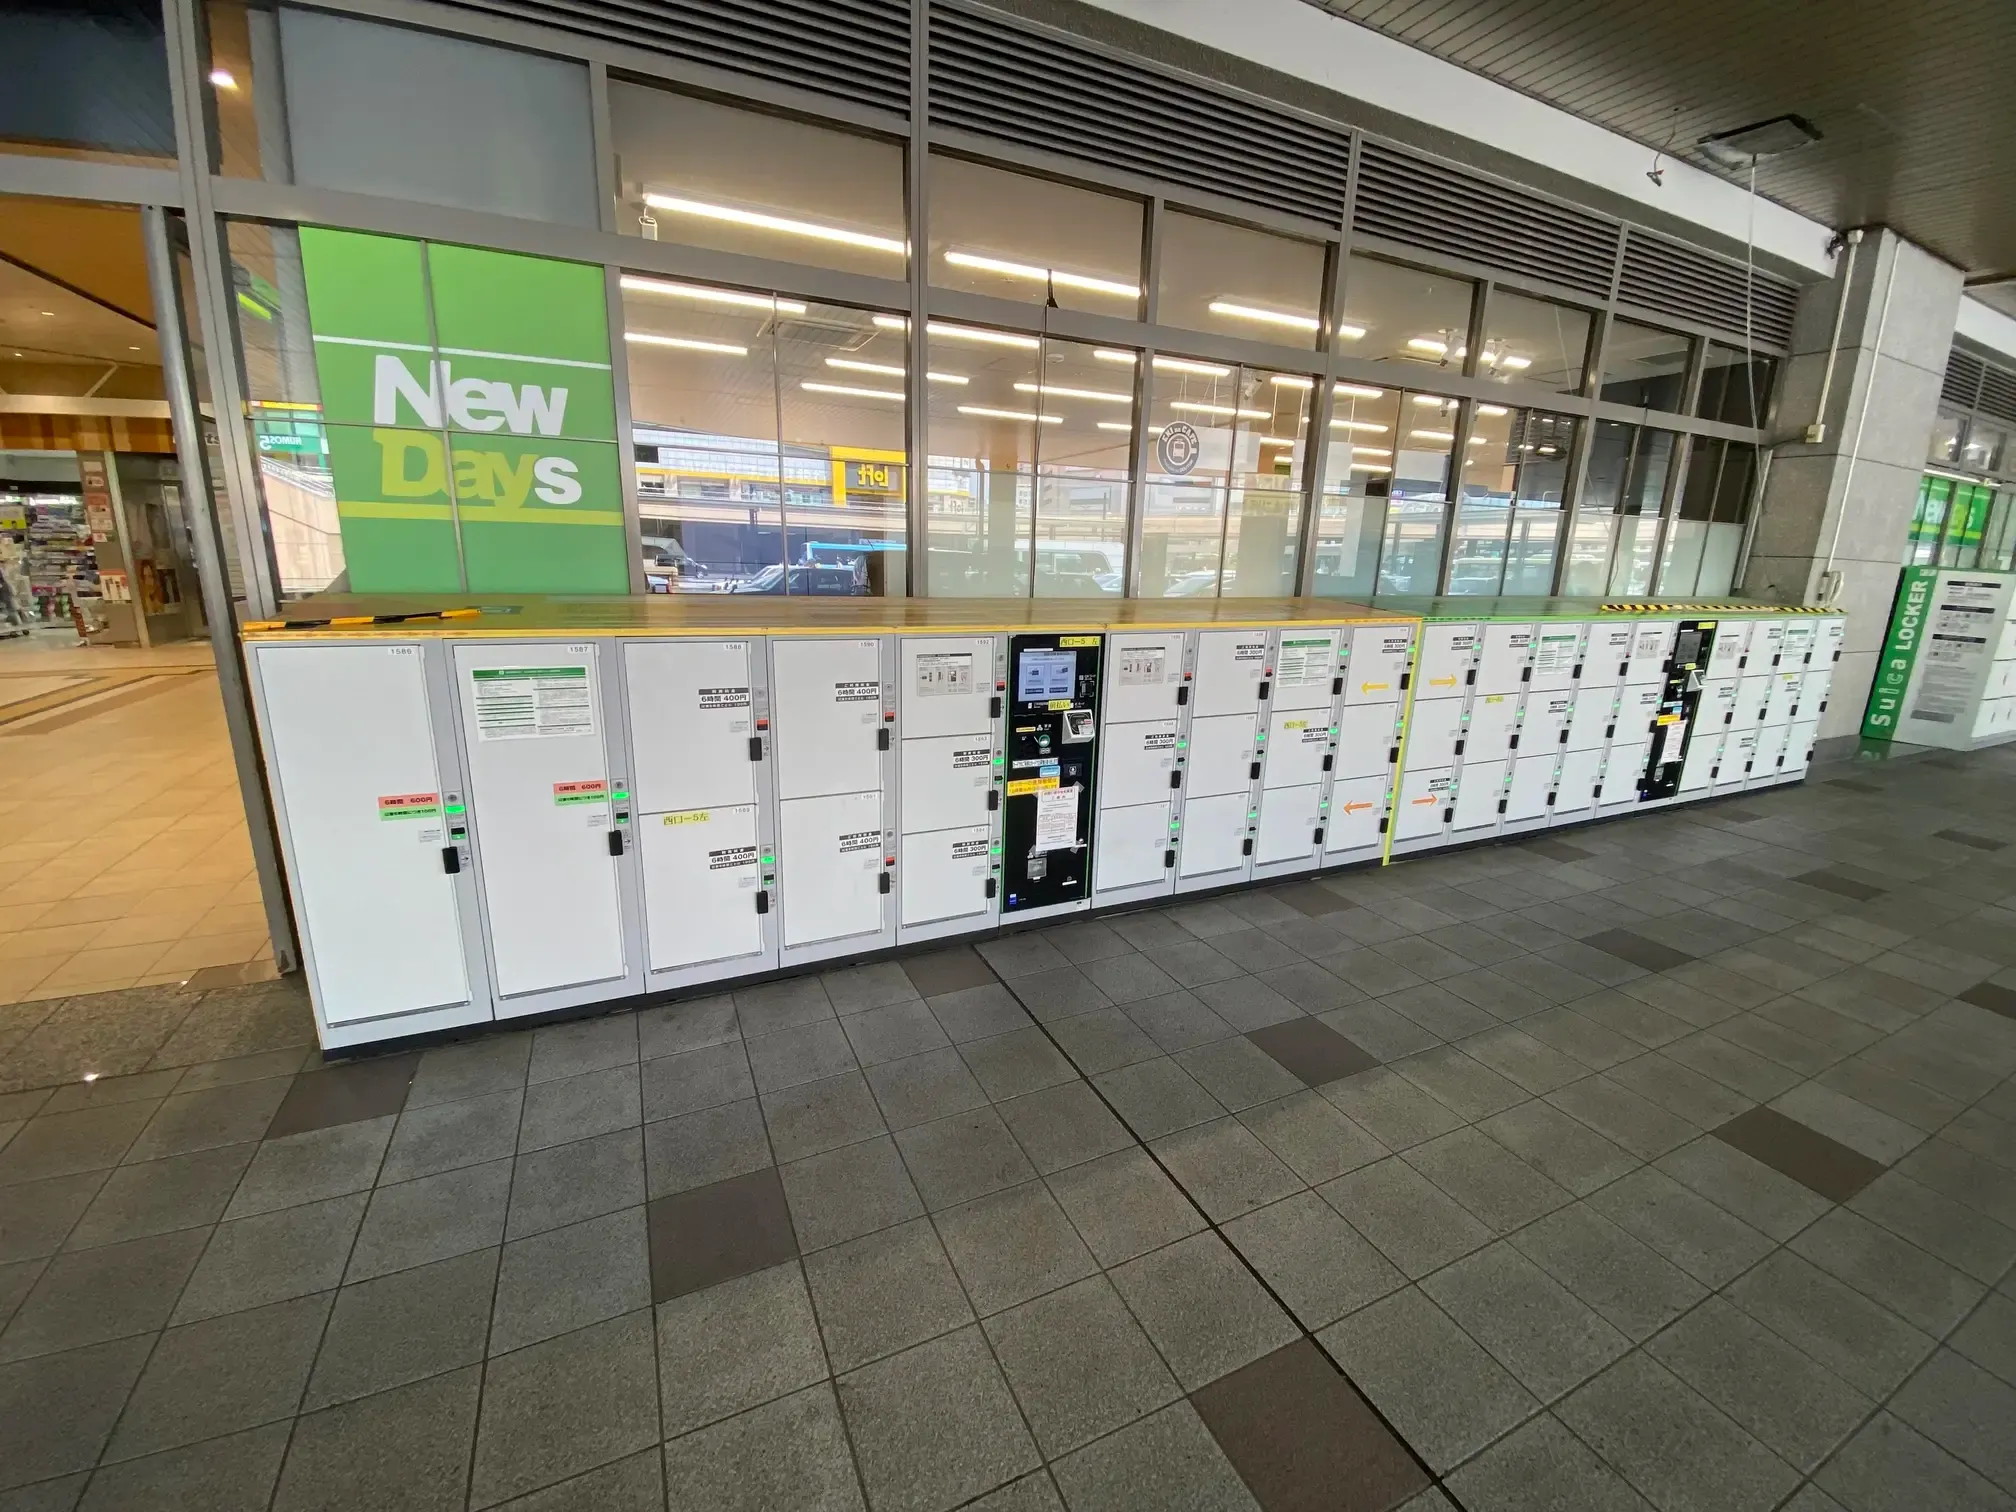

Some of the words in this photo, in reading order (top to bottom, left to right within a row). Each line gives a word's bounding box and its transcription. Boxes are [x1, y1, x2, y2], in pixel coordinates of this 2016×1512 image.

[374, 354, 568, 436] New
[373, 428, 582, 509] Days
[1870, 658, 1907, 726] Suica
[1895, 580, 1929, 651] LOCKER
[732, 852, 755, 860] 400円
